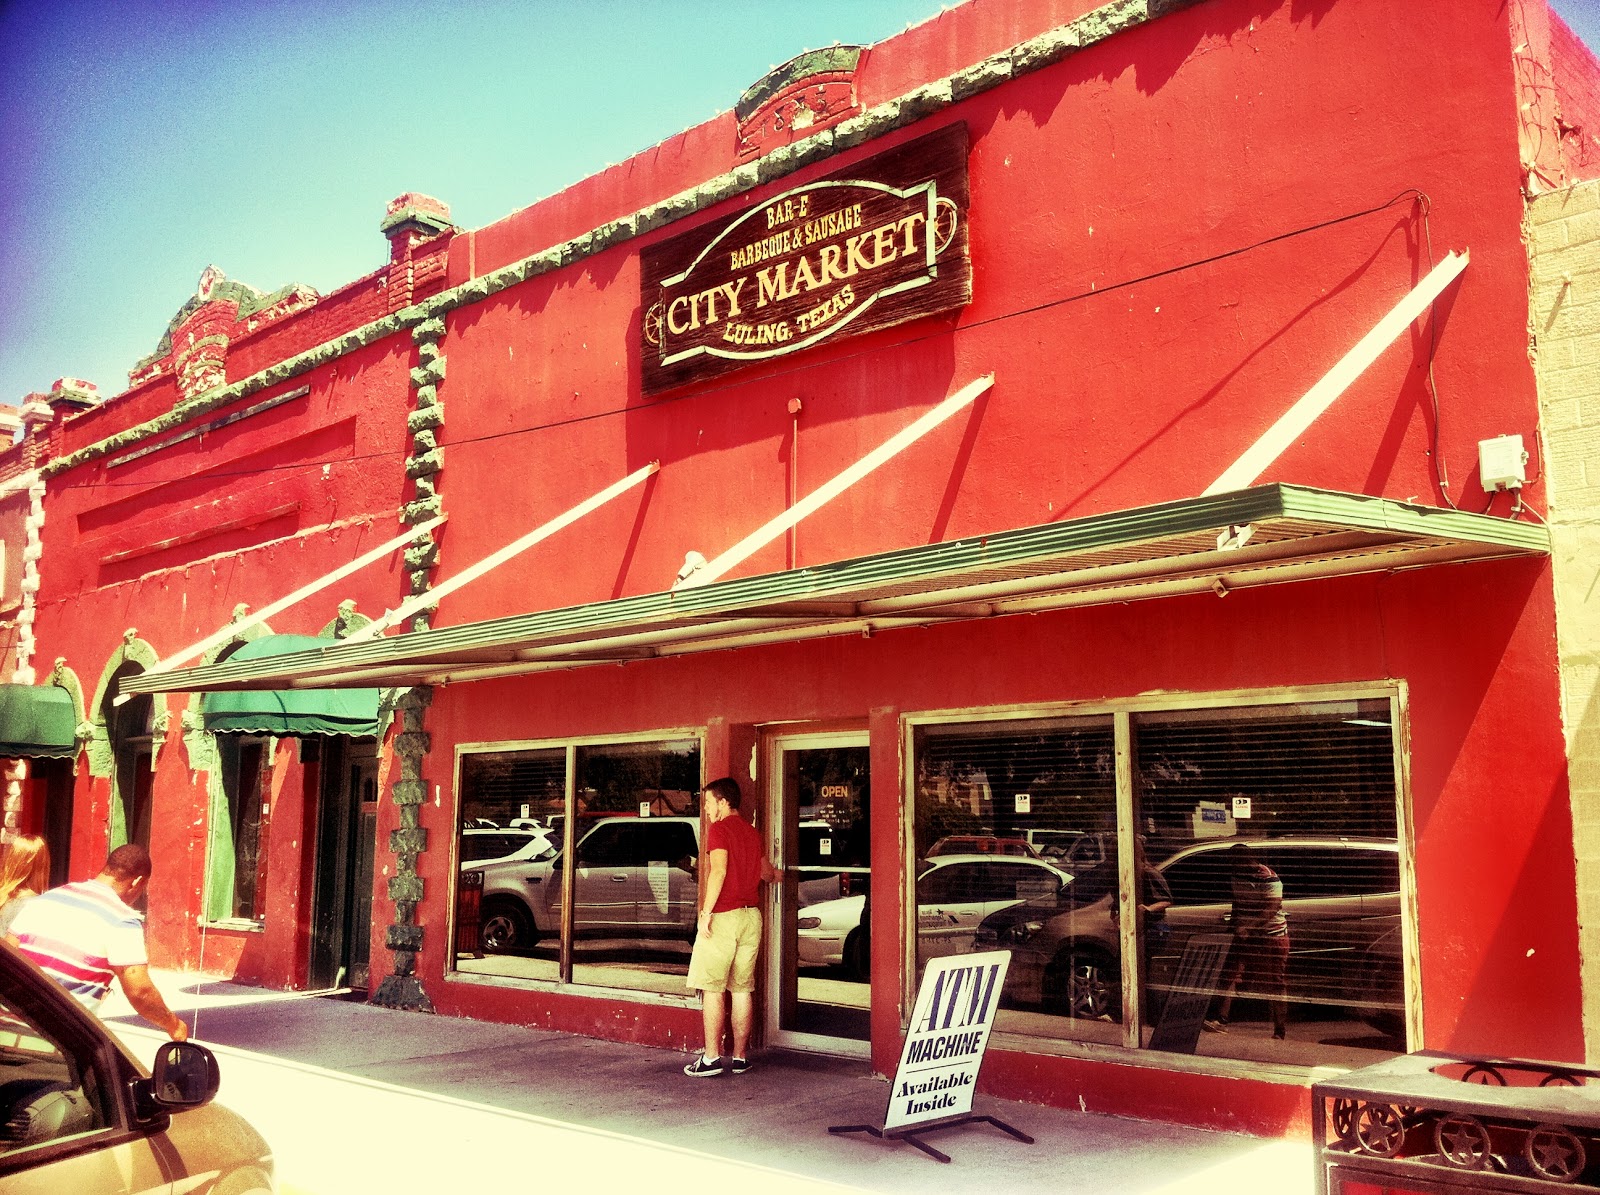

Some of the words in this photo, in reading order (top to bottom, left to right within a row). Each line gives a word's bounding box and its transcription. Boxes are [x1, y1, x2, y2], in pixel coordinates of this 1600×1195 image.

[766, 195, 809, 229] BAR-E
[730, 233, 790, 271] BARBEQUE
[791, 230, 803, 248] &
[805, 204, 862, 244] SAUSAGE
[667, 277, 748, 335] CITY
[756, 212, 925, 308] MARKET
[796, 284, 856, 333] TEXAS
[821, 785, 848, 798] OPEN
[915, 964, 1002, 1033] ATM
[906, 1031, 983, 1064] MACHINE
[896, 1071, 973, 1098] Available
[905, 1093, 957, 1115] Inside
